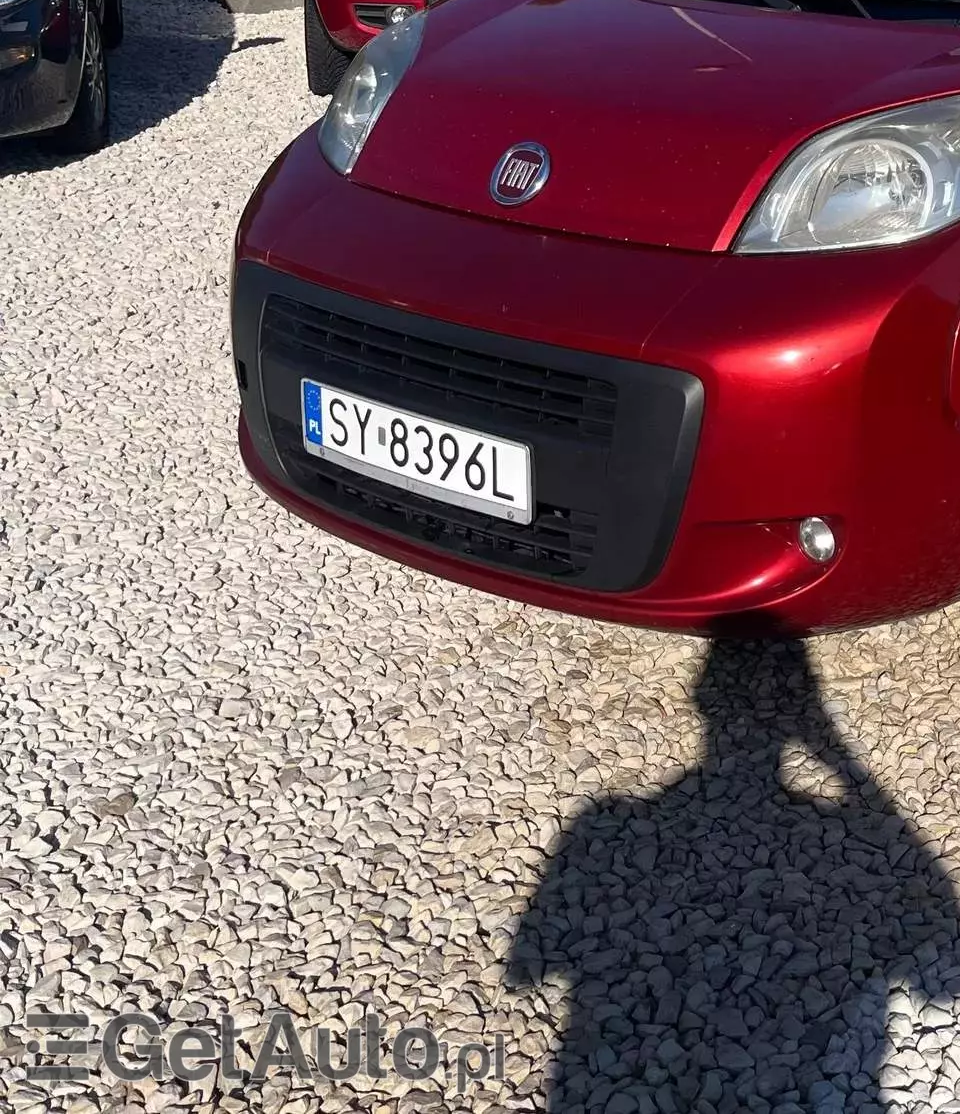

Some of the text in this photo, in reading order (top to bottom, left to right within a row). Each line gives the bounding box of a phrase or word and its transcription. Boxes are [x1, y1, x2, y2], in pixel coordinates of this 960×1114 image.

[500, 157, 540, 190] FIAT
[309, 418, 321, 435] PL
[329, 397, 515, 502] SY 8396L
